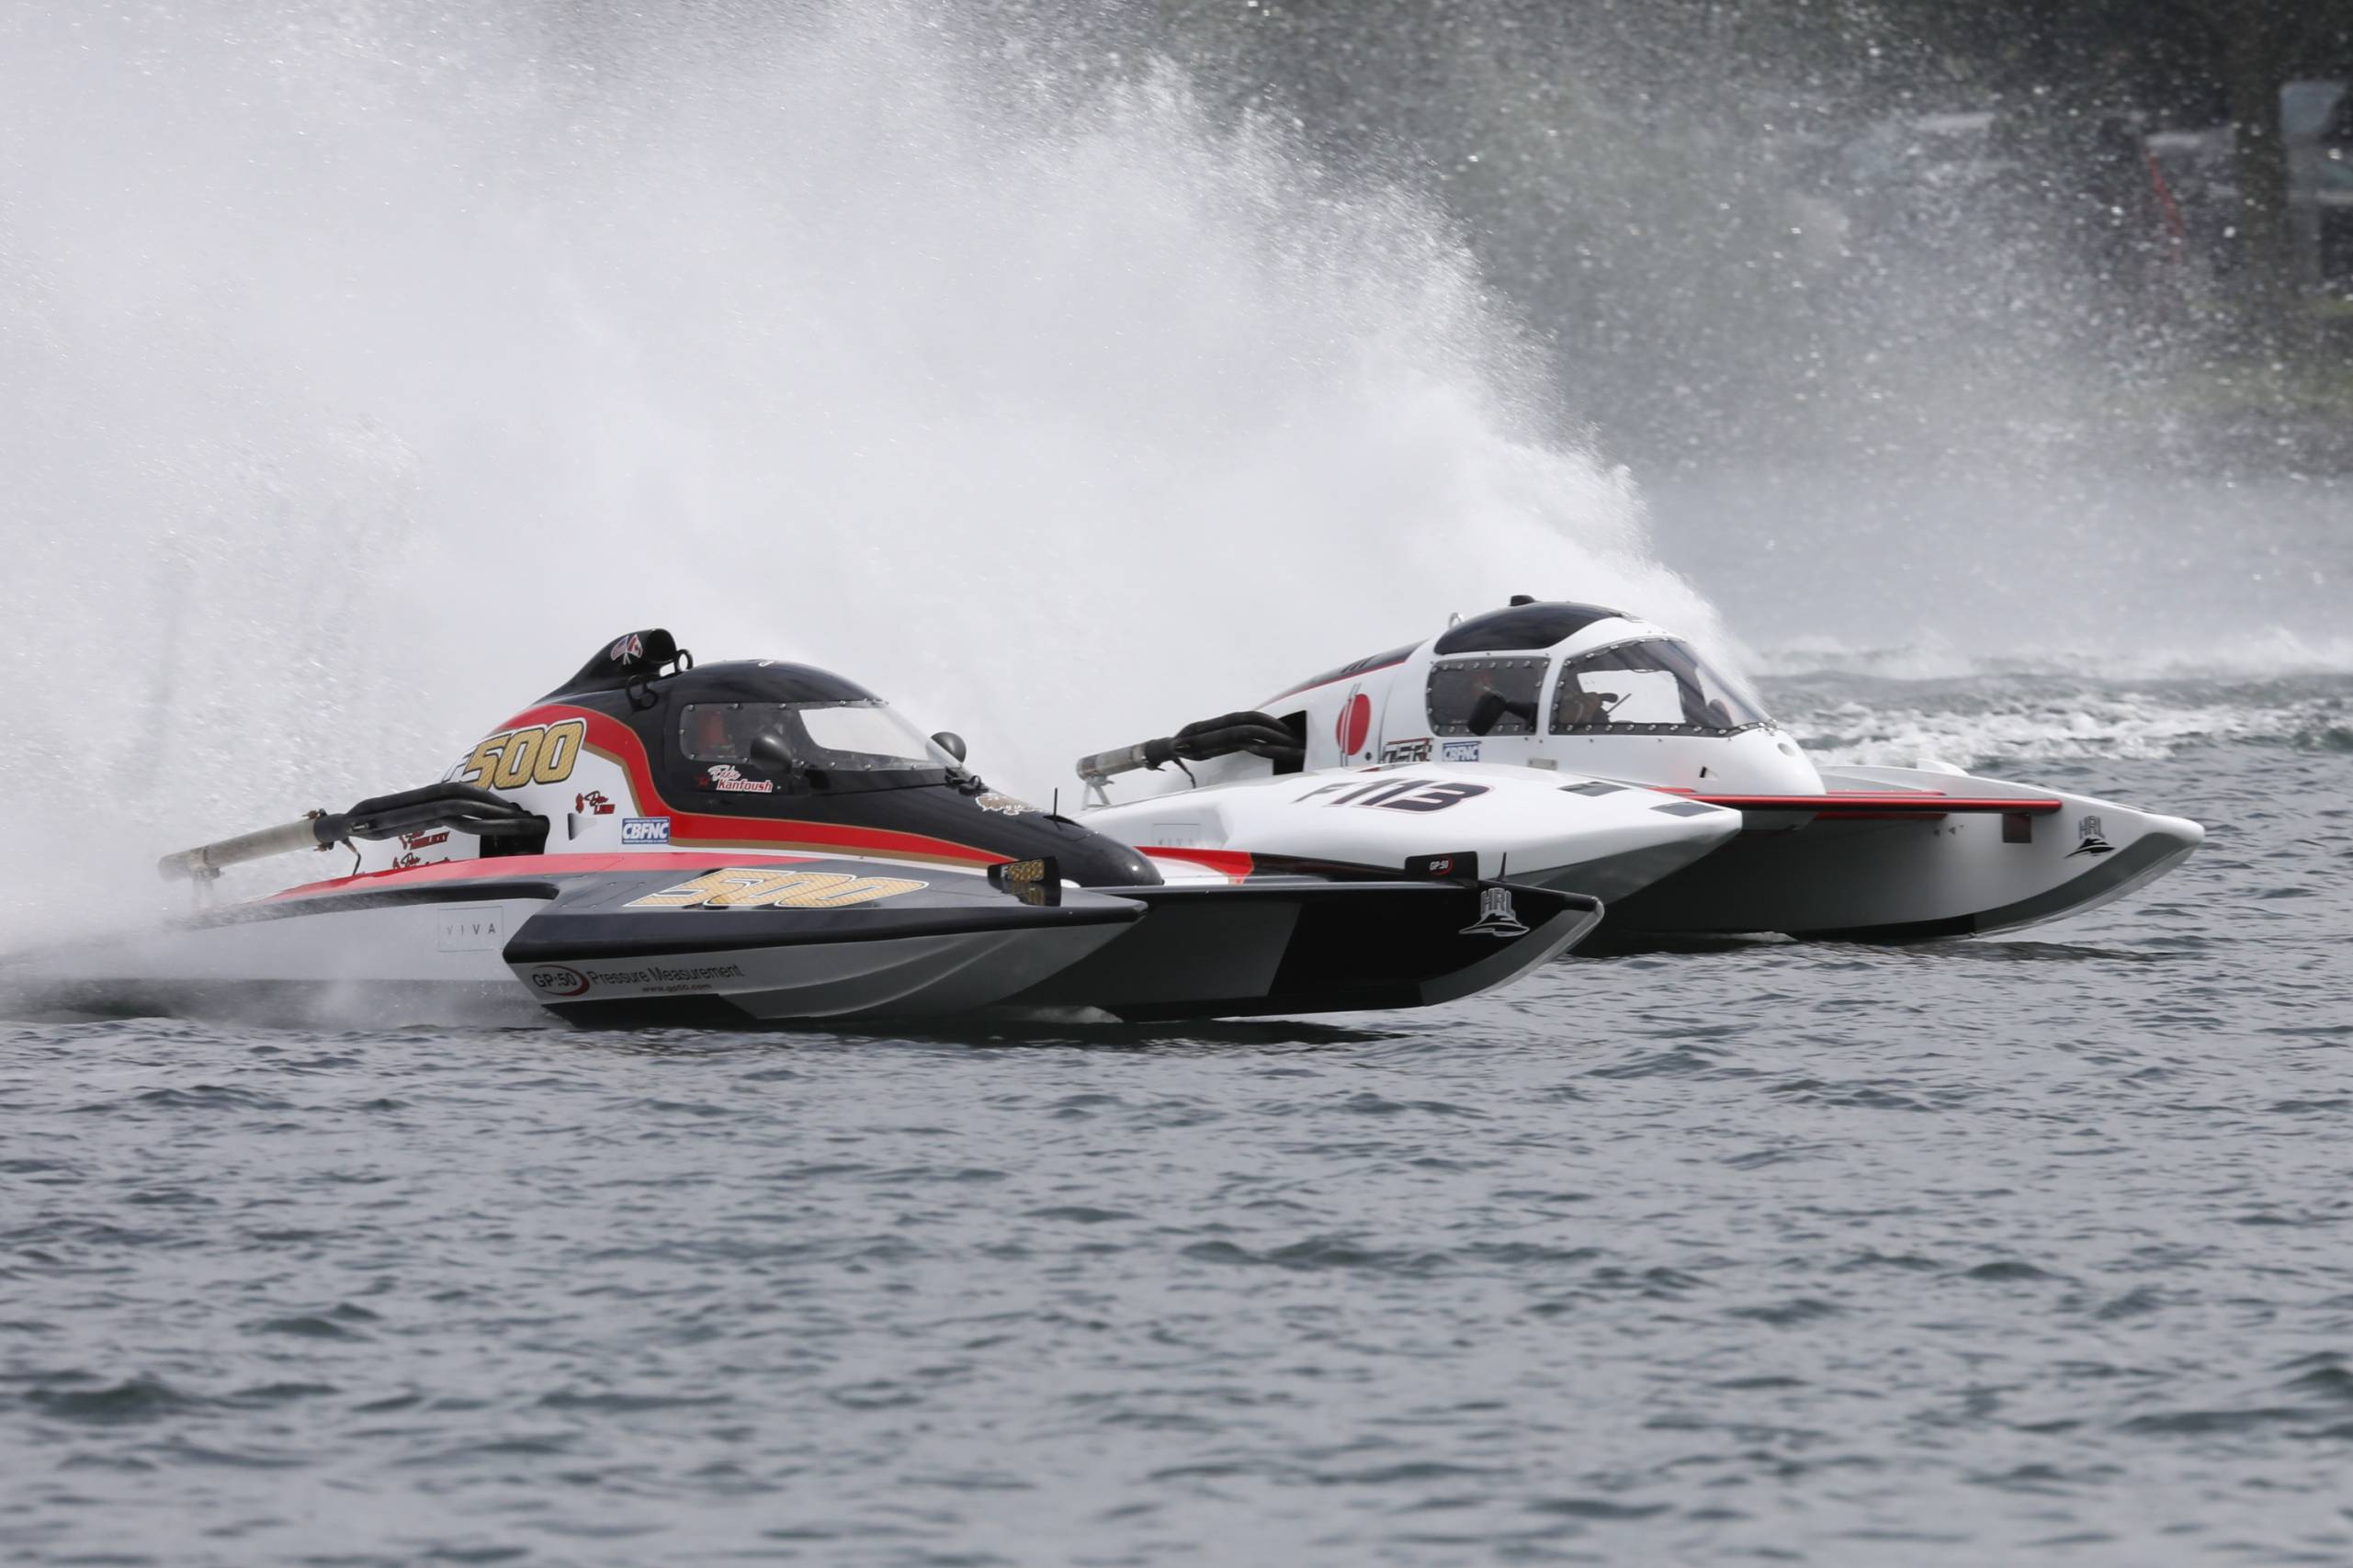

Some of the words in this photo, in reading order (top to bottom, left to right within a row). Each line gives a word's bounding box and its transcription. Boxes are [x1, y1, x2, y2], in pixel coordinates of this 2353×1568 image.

[718, 779, 773, 792] Kanfoush
[623, 822, 669, 840] CBFNC
[623, 868, 929, 908] 500
[447, 922, 497, 936] VIVA
[587, 971, 650, 986] Pressure
[647, 964, 745, 982] Measurement
